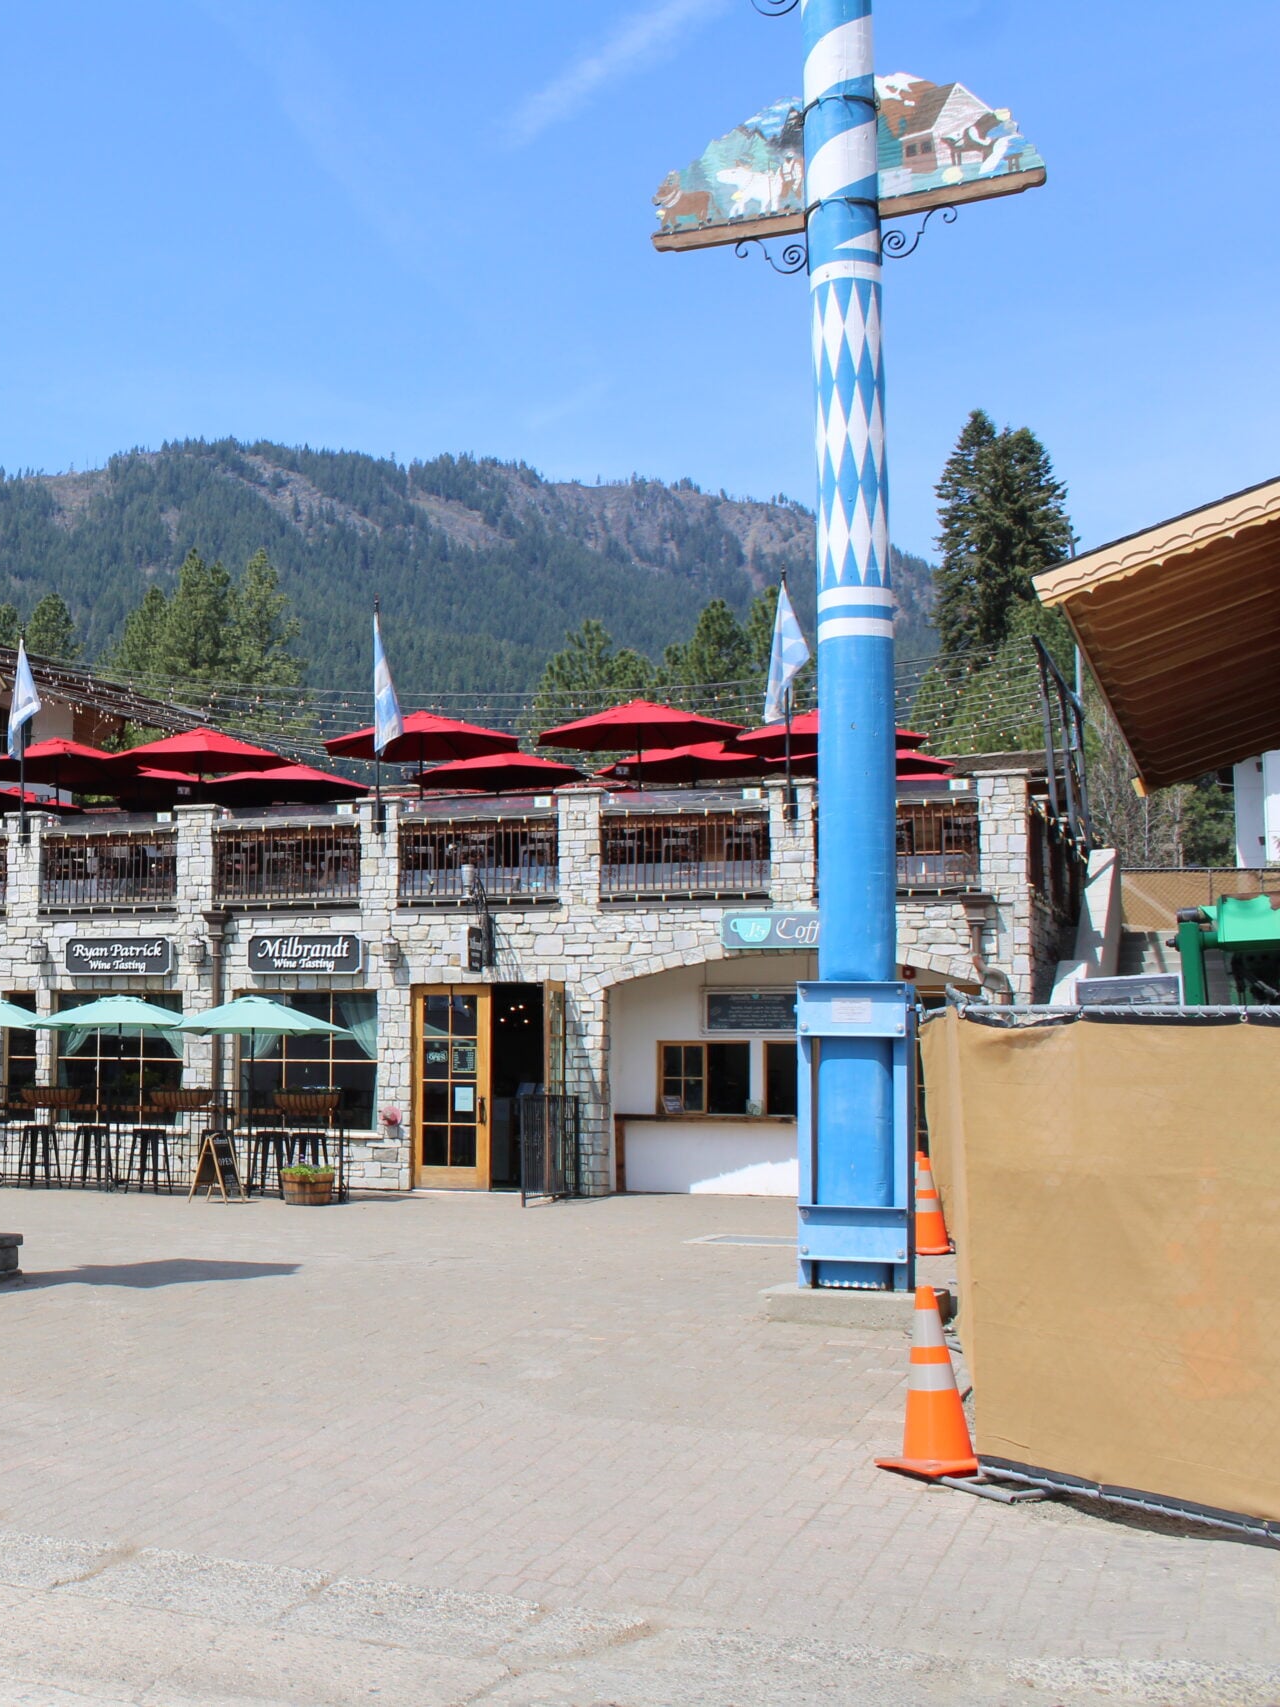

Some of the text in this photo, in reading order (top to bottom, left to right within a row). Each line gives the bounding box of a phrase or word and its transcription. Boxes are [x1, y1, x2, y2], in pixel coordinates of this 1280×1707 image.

[776, 917, 820, 944] Coff
[72, 941, 163, 962] Ryan Patrick
[257, 936, 350, 958] Milbrandt
[89, 958, 147, 973] Wine Tasting
[273, 957, 336, 973] Wine Tasting
